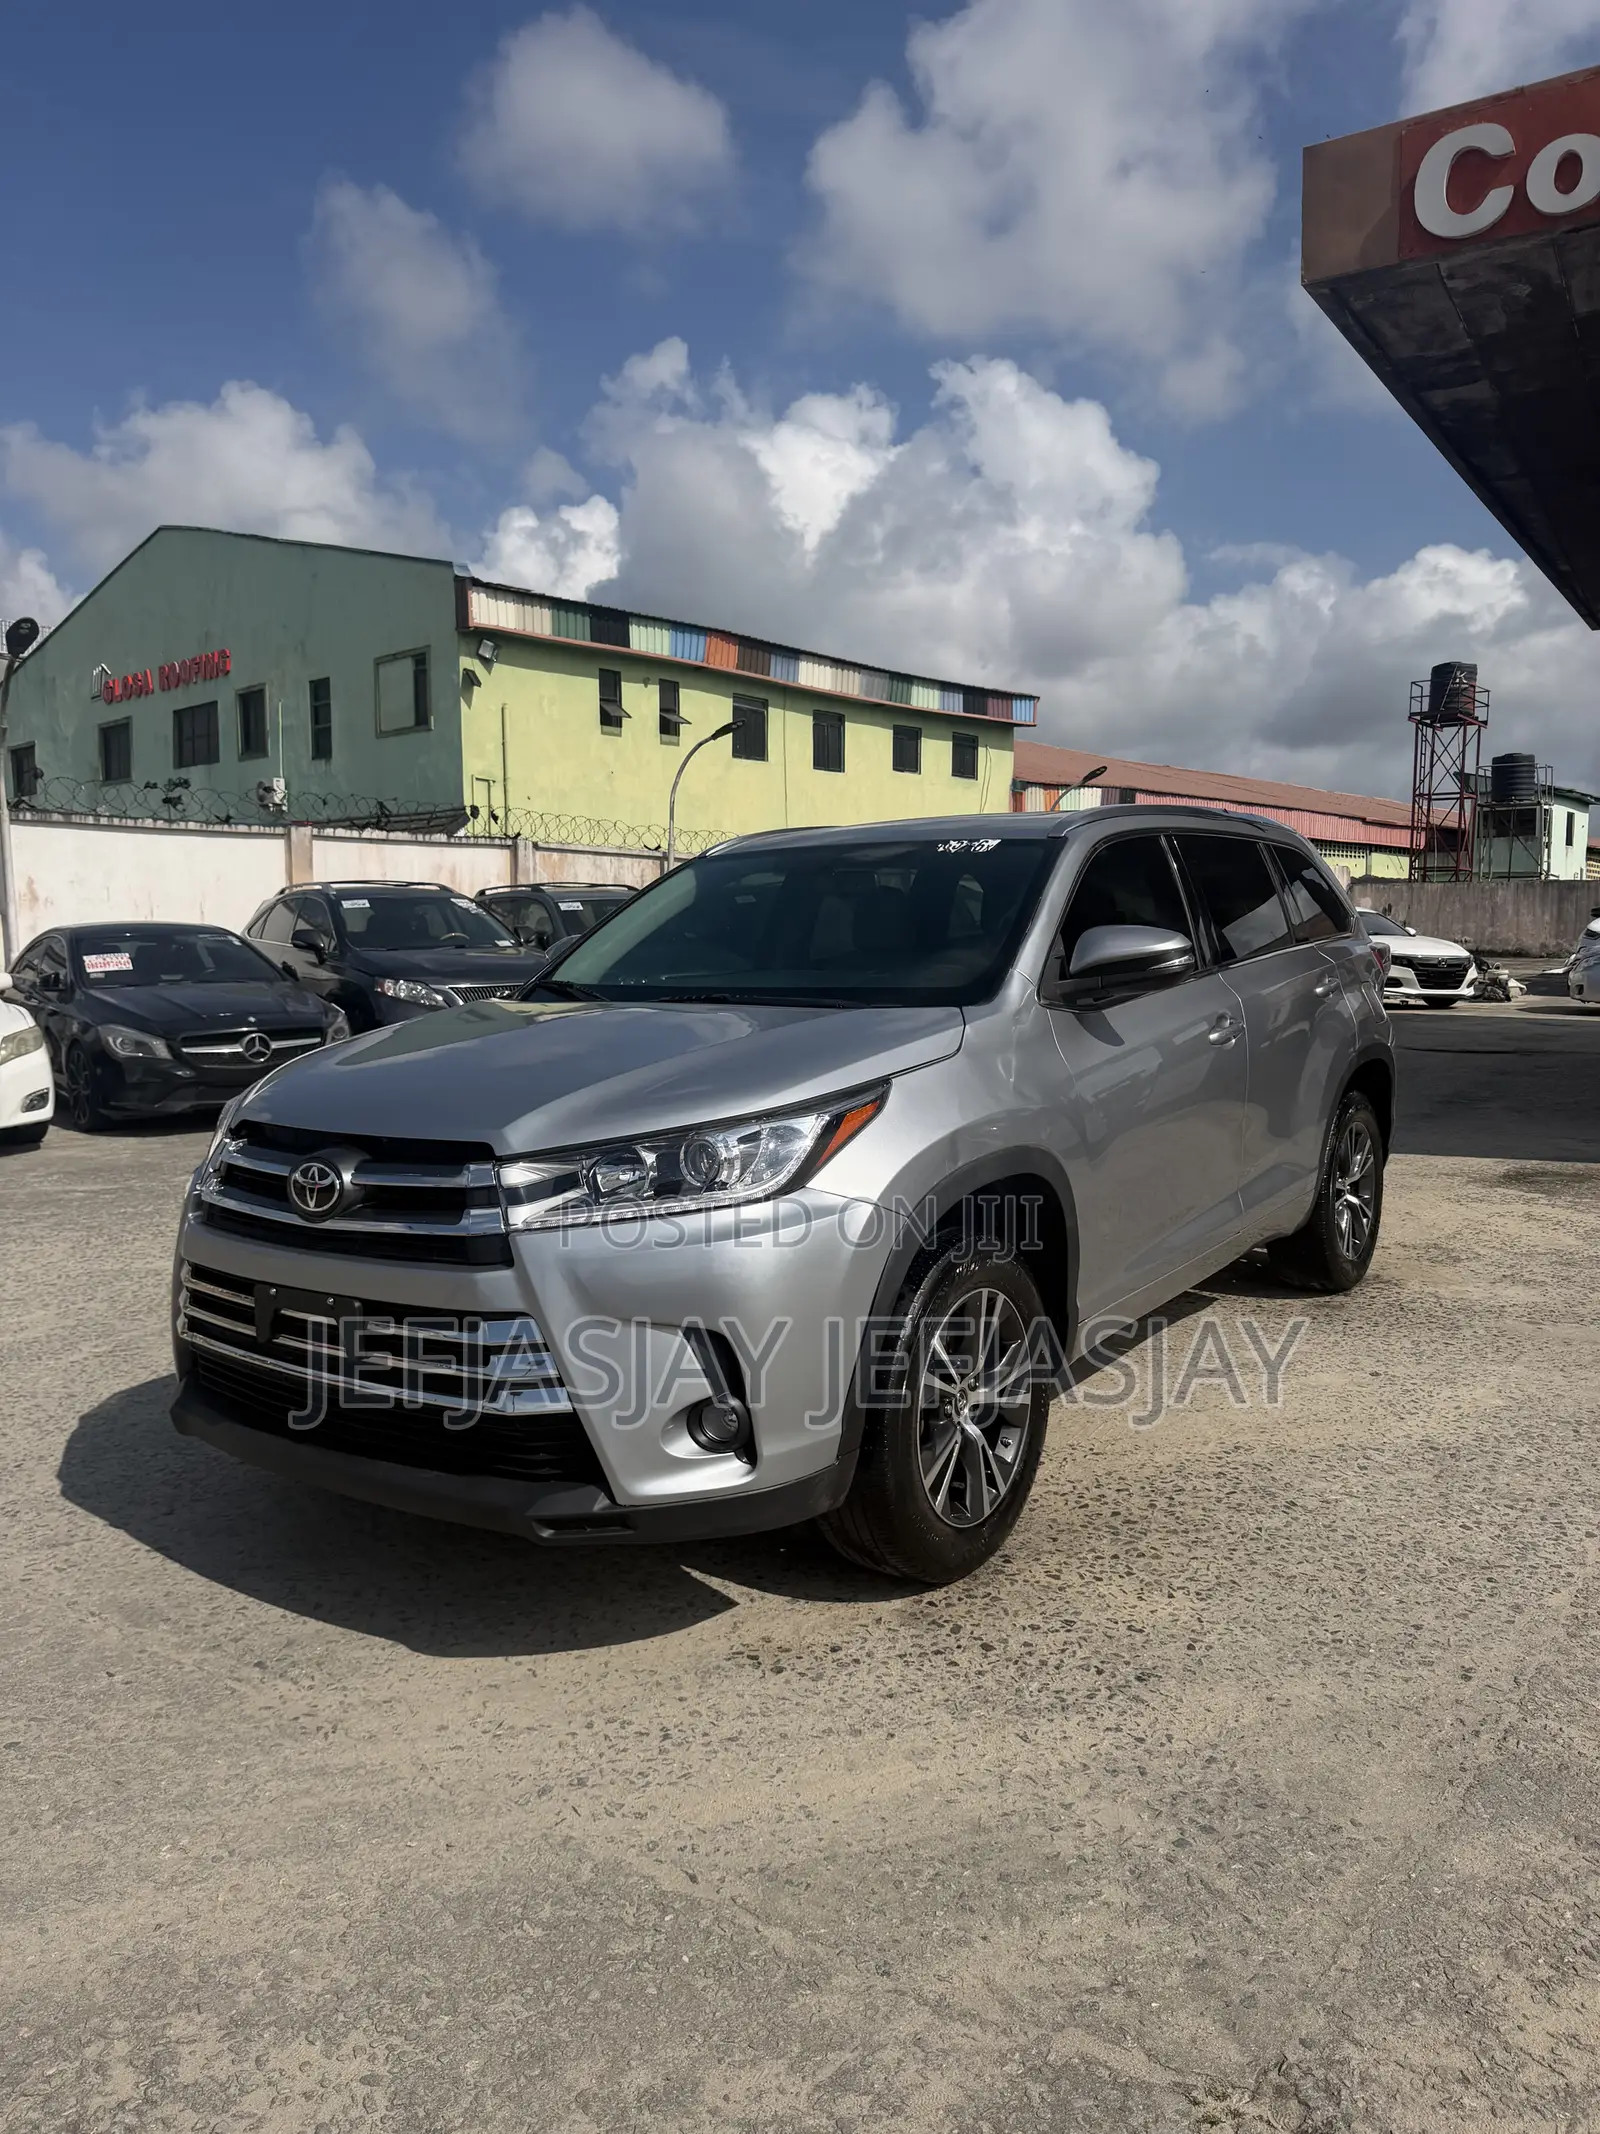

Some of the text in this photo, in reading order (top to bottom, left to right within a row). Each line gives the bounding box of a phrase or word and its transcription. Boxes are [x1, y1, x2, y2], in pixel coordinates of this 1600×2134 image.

[1414, 122, 1600, 239] Co
[104, 648, 231, 704] GLOSA ROOFING
